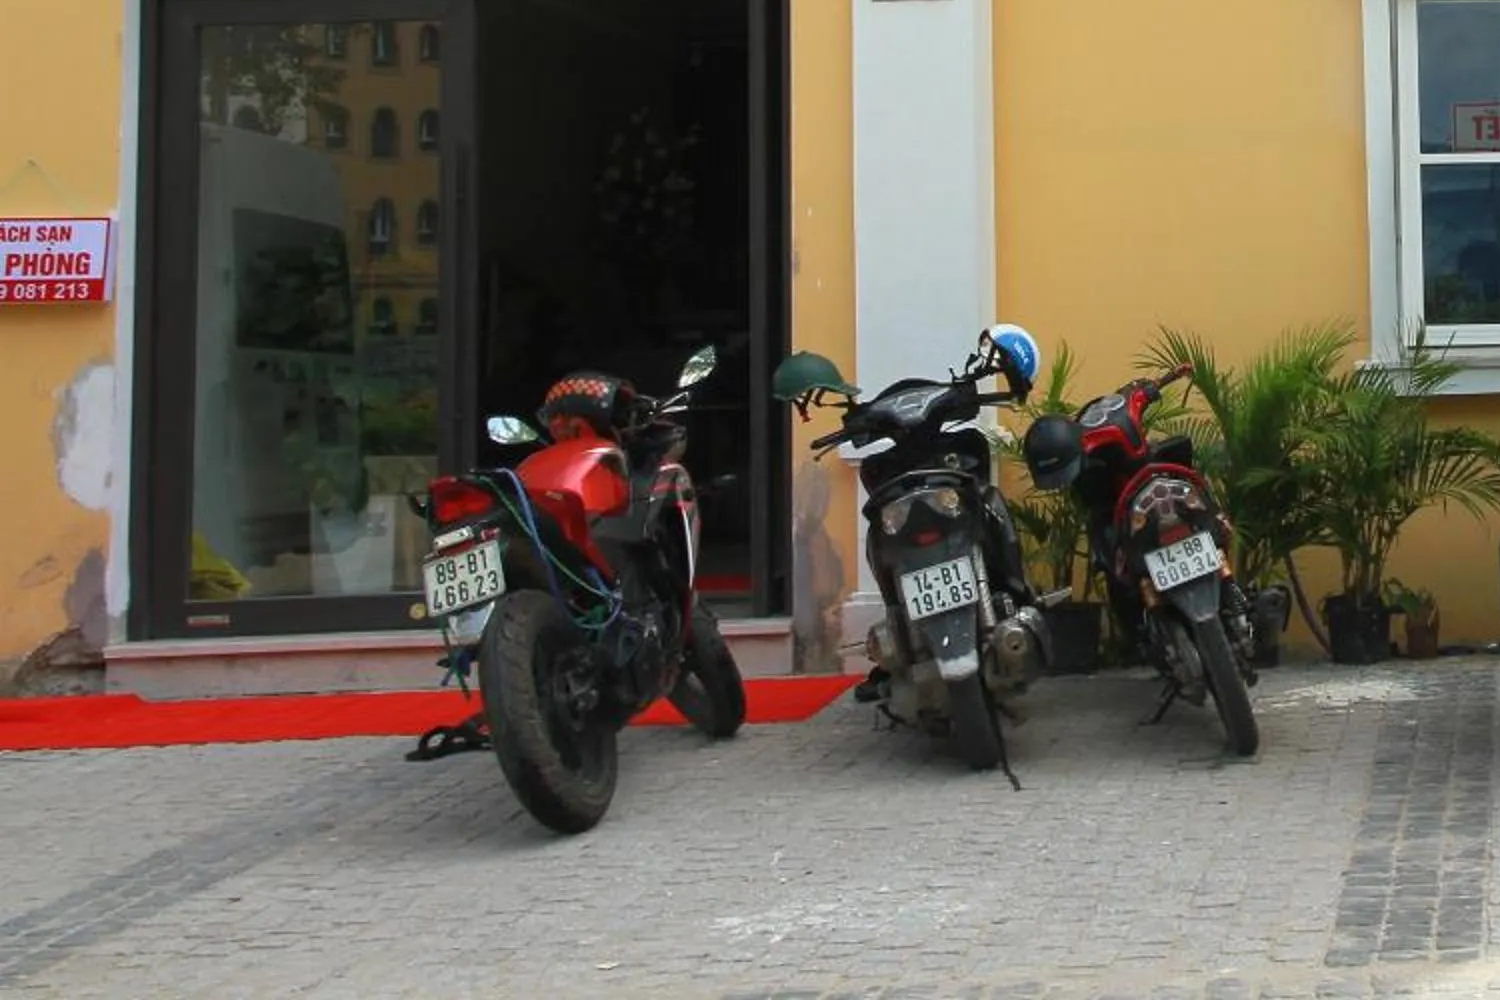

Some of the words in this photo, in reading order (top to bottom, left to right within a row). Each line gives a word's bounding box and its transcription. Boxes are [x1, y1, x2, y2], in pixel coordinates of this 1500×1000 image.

[36, 224, 72, 246] SẠN
[13, 283, 48, 299] 081
[54, 283, 89, 299] 213
[435, 549, 488, 585] 89-B1
[913, 563, 962, 594] 14-B1
[433, 570, 499, 611] 466.23
